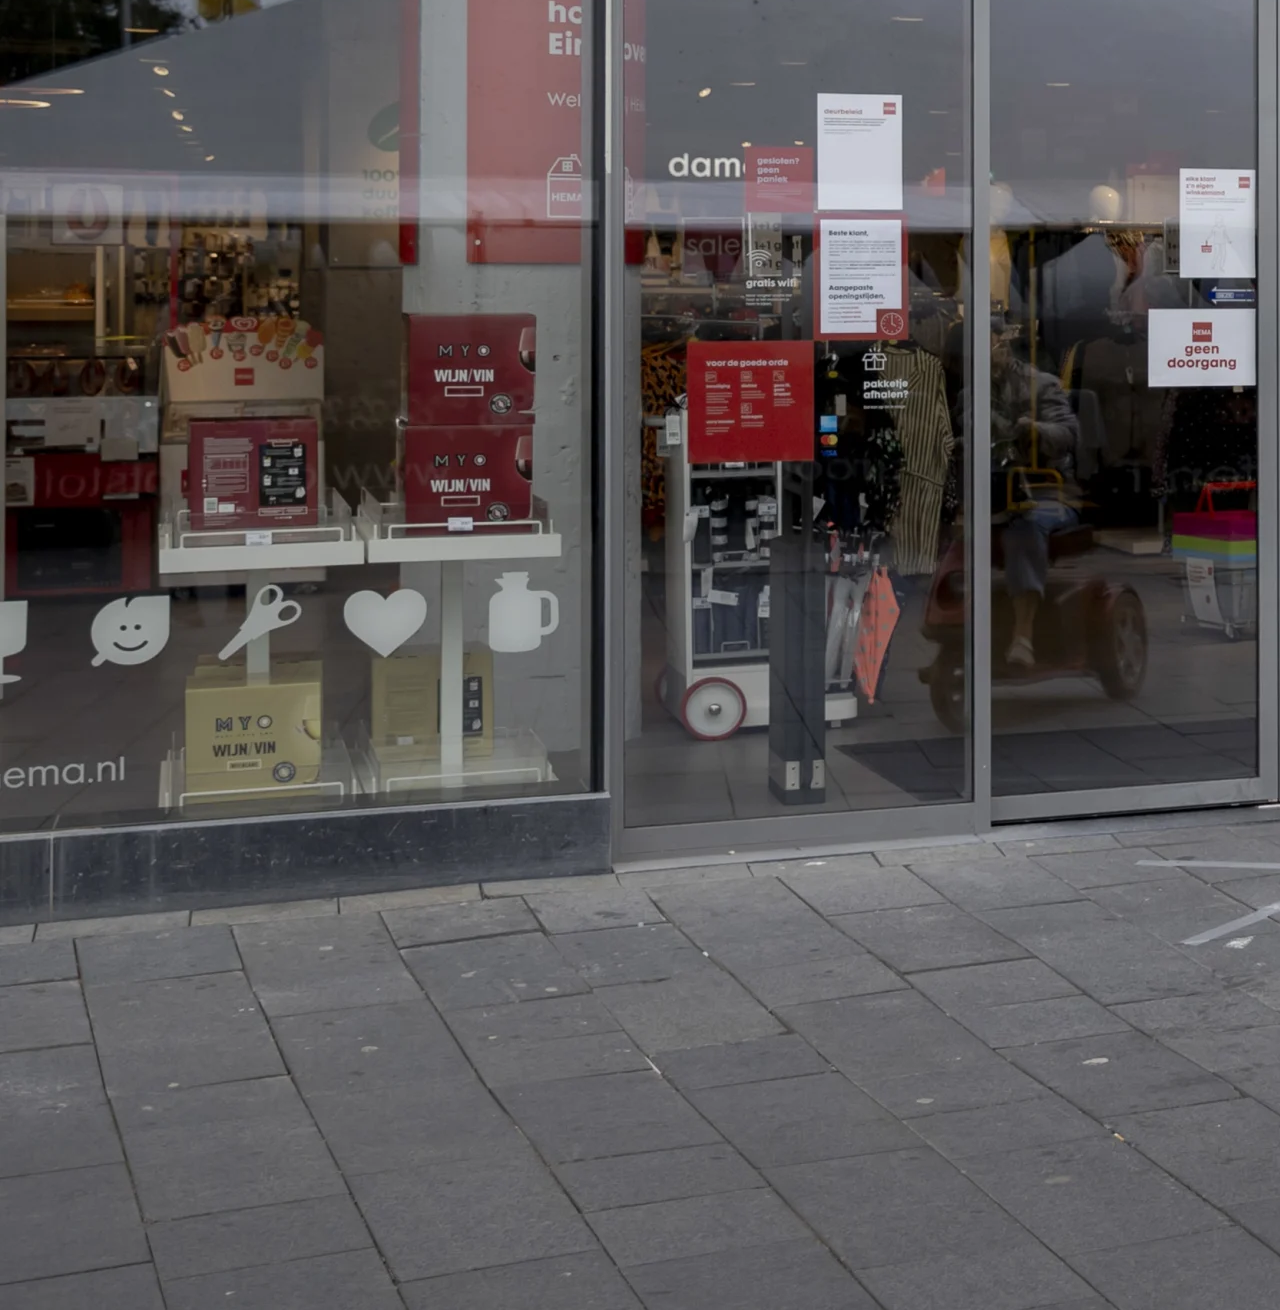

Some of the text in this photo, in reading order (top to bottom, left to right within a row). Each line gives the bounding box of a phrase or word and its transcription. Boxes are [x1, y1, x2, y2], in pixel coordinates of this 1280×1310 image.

[757, 157, 800, 167] gesloten?
[757, 166, 780, 176] geen
[757, 175, 788, 184] paniek
[848, 230, 869, 238] klant,
[686, 235, 741, 257] sale
[745, 278, 798, 290] gratis wifi
[828, 285, 874, 293] Aangepaste
[1185, 344, 1220, 357] geen
[705, 358, 789, 369] voor de goede orde
[1167, 357, 1237, 370] doorgang
[434, 369, 494, 383] WIJN/VIN
[863, 379, 909, 390] pakketje
[863, 390, 909, 399] afhalen?
[430, 478, 491, 493] WIJN/VIN
[212, 741, 276, 757] WIJN/VIN
[0, 756, 126, 789] ema.nl
